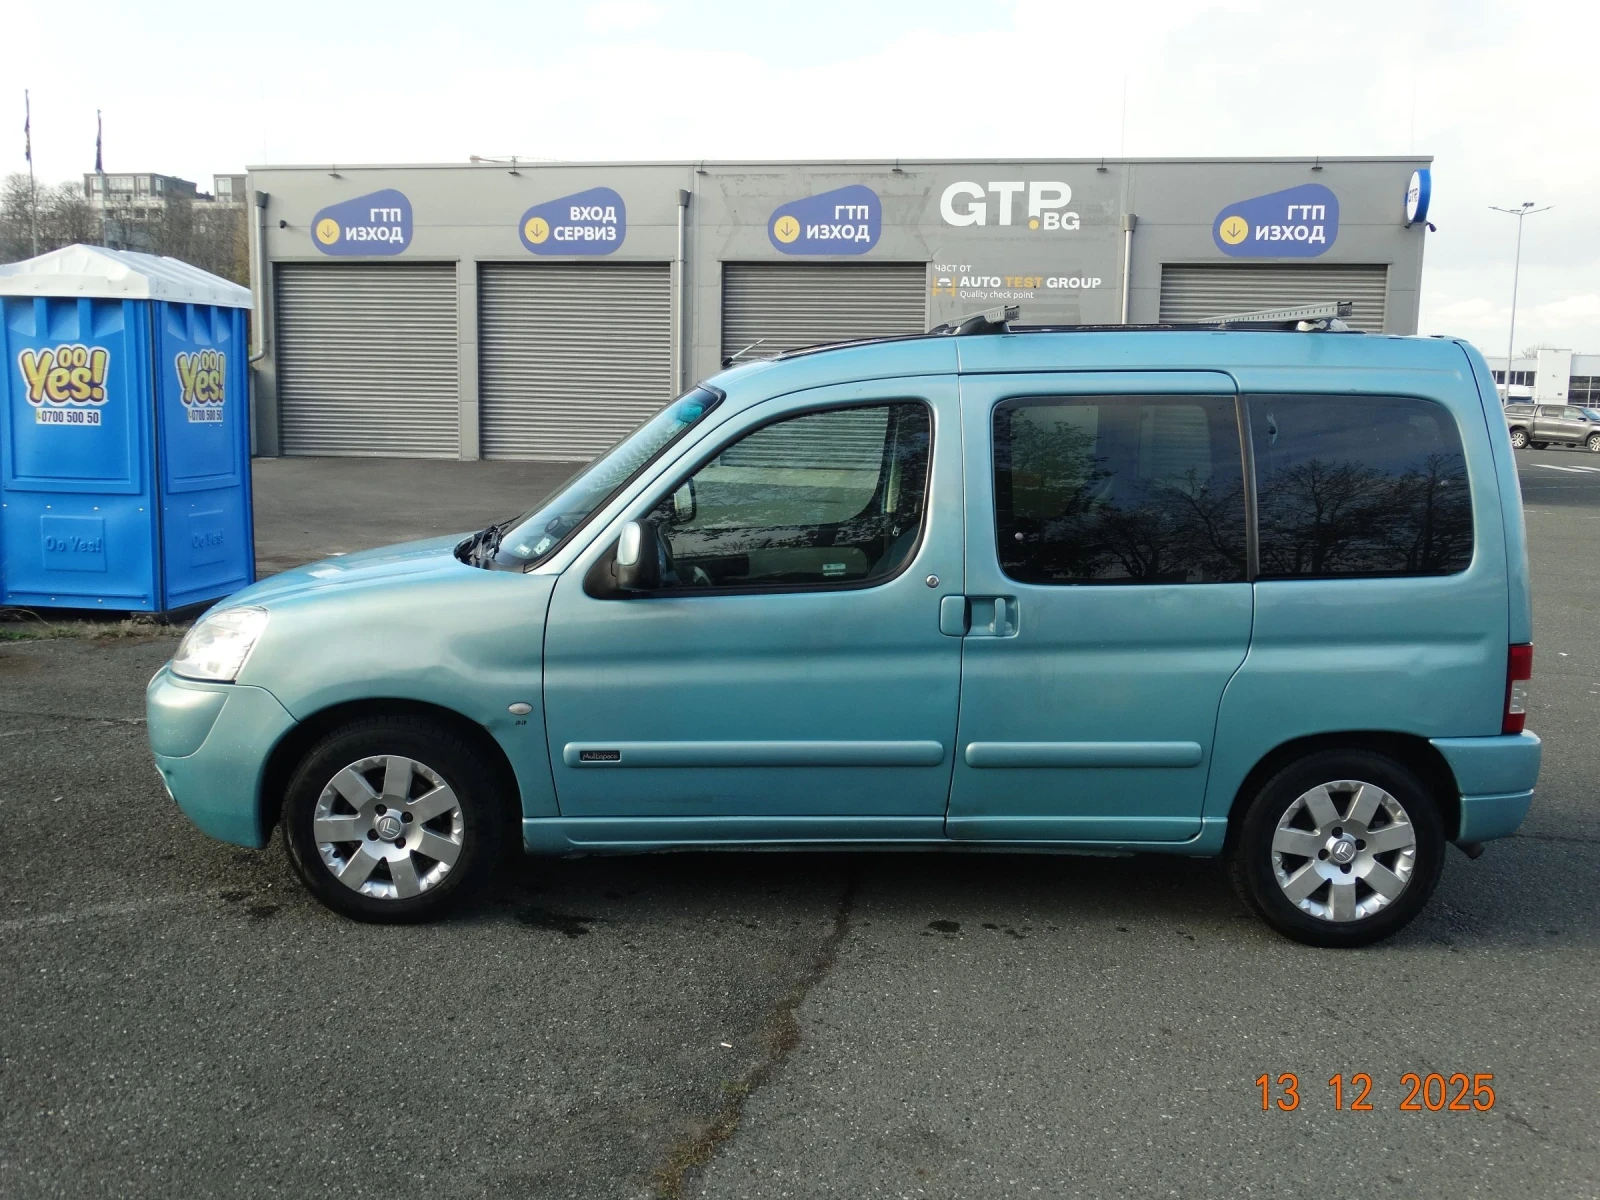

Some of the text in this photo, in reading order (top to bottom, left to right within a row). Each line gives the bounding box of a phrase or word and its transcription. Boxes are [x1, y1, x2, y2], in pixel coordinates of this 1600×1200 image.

[370, 208, 401, 222] ГТП
[570, 206, 617, 224] ВХОД
[835, 205, 869, 220] ГТП
[1287, 204, 1326, 220] ГТП
[345, 227, 404, 244] ИЗХОД
[553, 226, 617, 241] СЕРВИЗ
[806, 224, 870, 243] ИЗХОД
[1255, 225, 1326, 244] ИЗХОД
[959, 264, 972, 272] от
[960, 276, 1102, 289] AUTO TEST GROUP
[960, 290, 1034, 299] Quality check point
[21, 350, 107, 403] Yes!
[177, 353, 225, 404] Yes!
[42, 410, 99, 424] 0700 500 50
